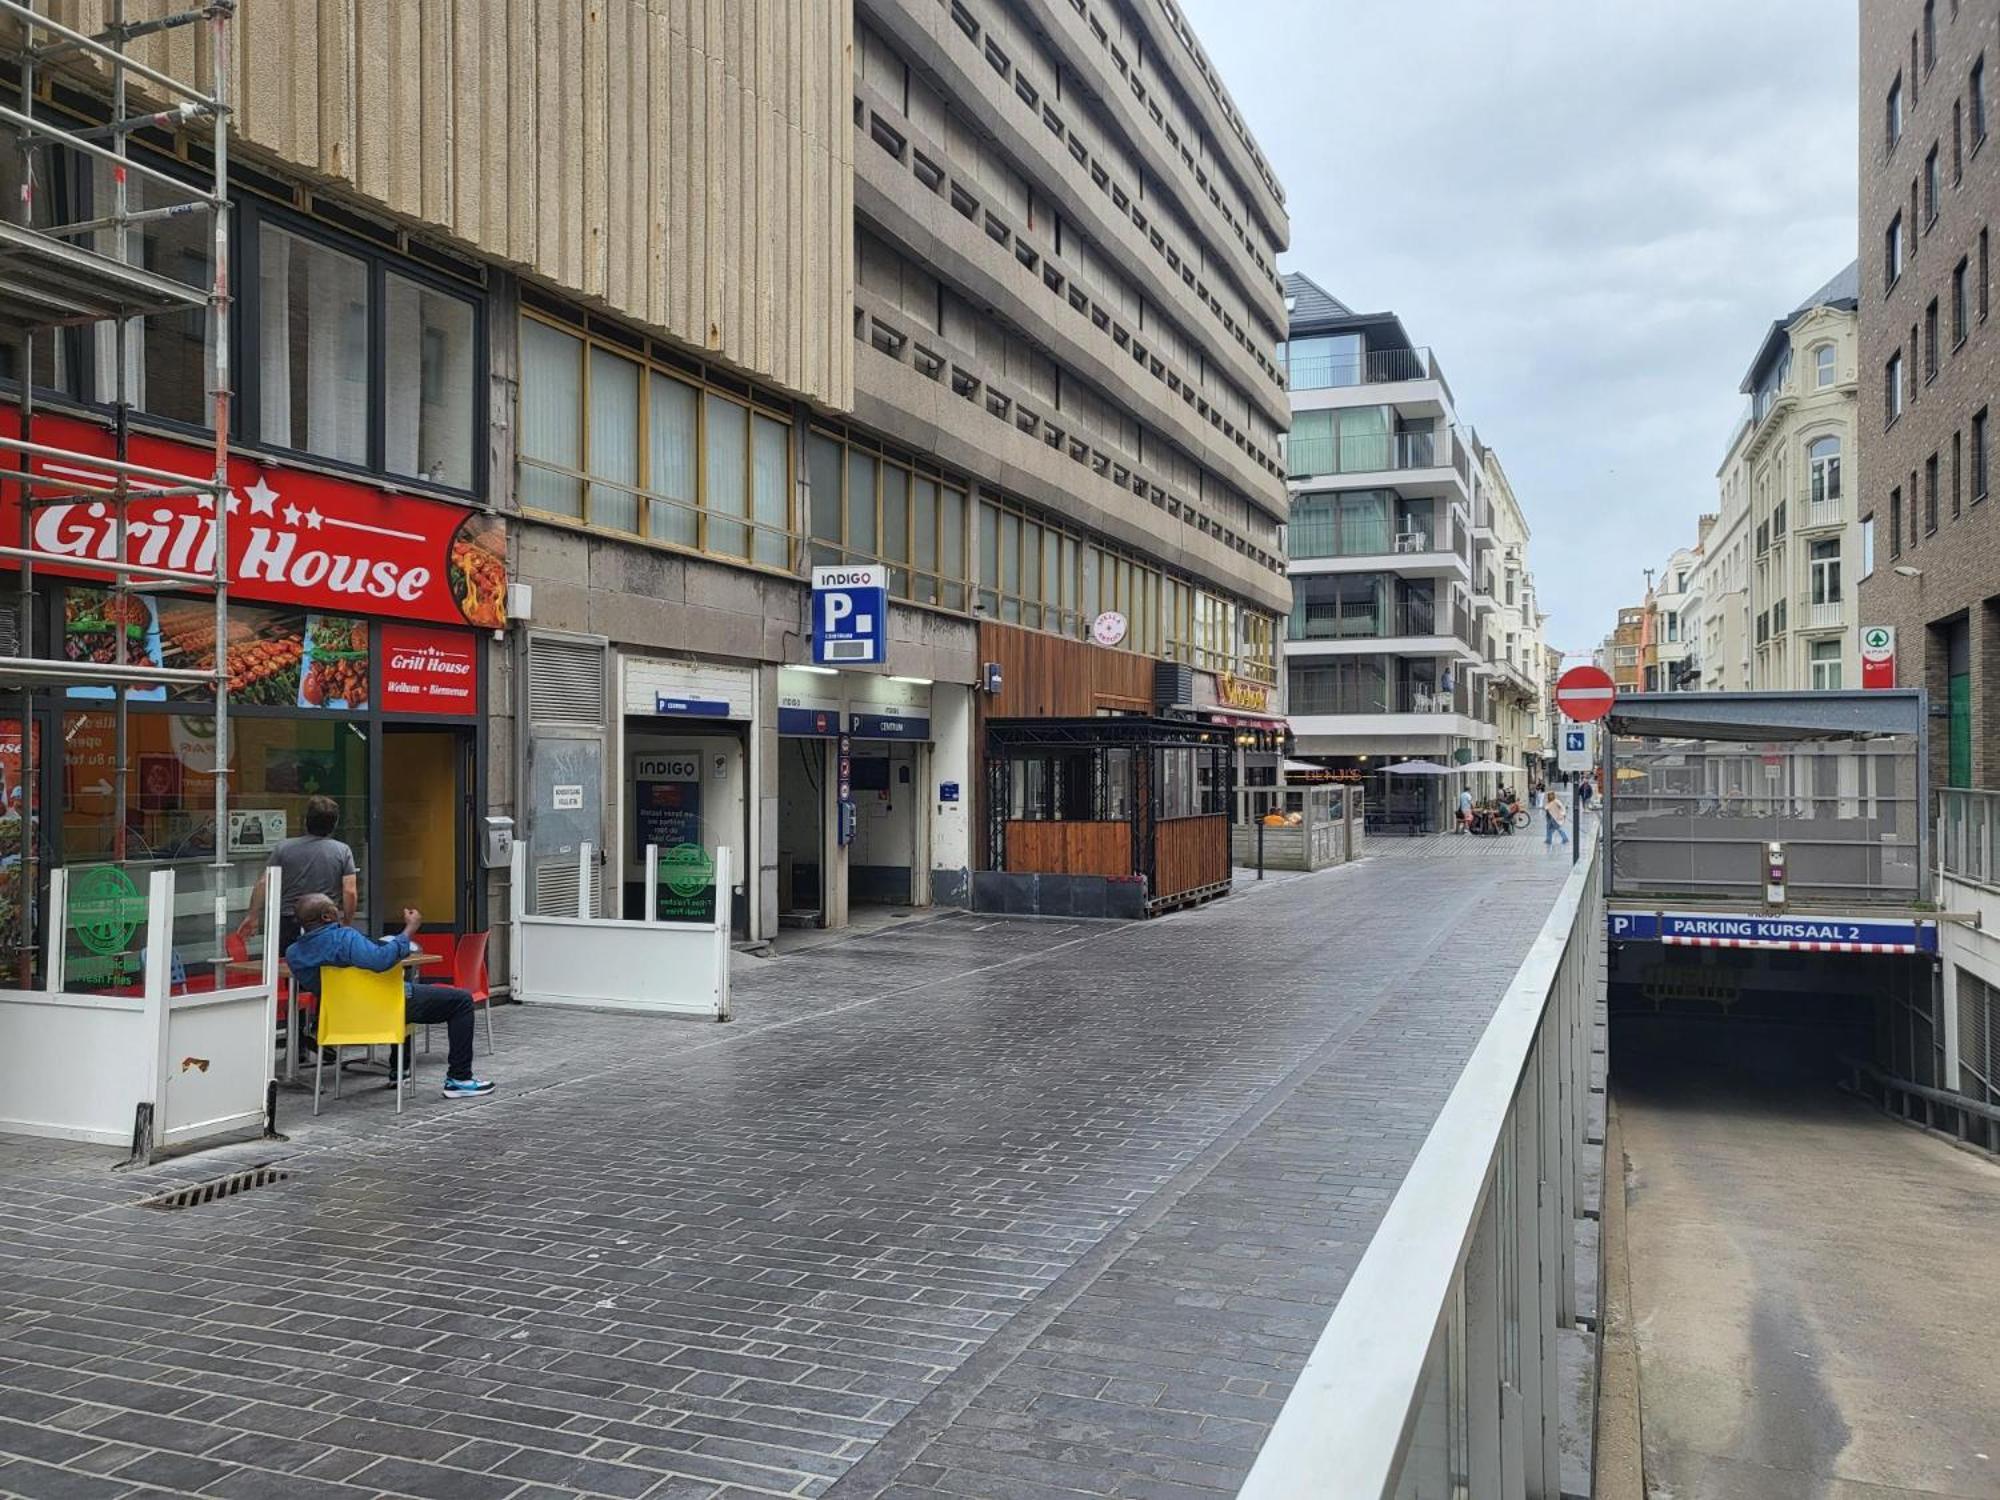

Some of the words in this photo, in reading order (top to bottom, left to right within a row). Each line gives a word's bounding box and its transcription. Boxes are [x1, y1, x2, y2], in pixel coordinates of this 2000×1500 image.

[35, 500, 218, 573] Grill
[239, 526, 430, 601] House
[822, 573, 871, 585] INDIGO
[825, 593, 852, 632] P
[391, 654, 425, 671] Grill
[426, 658, 470, 674] House
[854, 717, 860, 731] P
[880, 722, 904, 732] CENTRUM
[640, 762, 694, 776] INDIGO
[1614, 917, 1629, 934] P
[1674, 920, 1751, 935] PARKING
[1757, 923, 1843, 939] KURSAAL
[1848, 927, 1860, 939] 2
